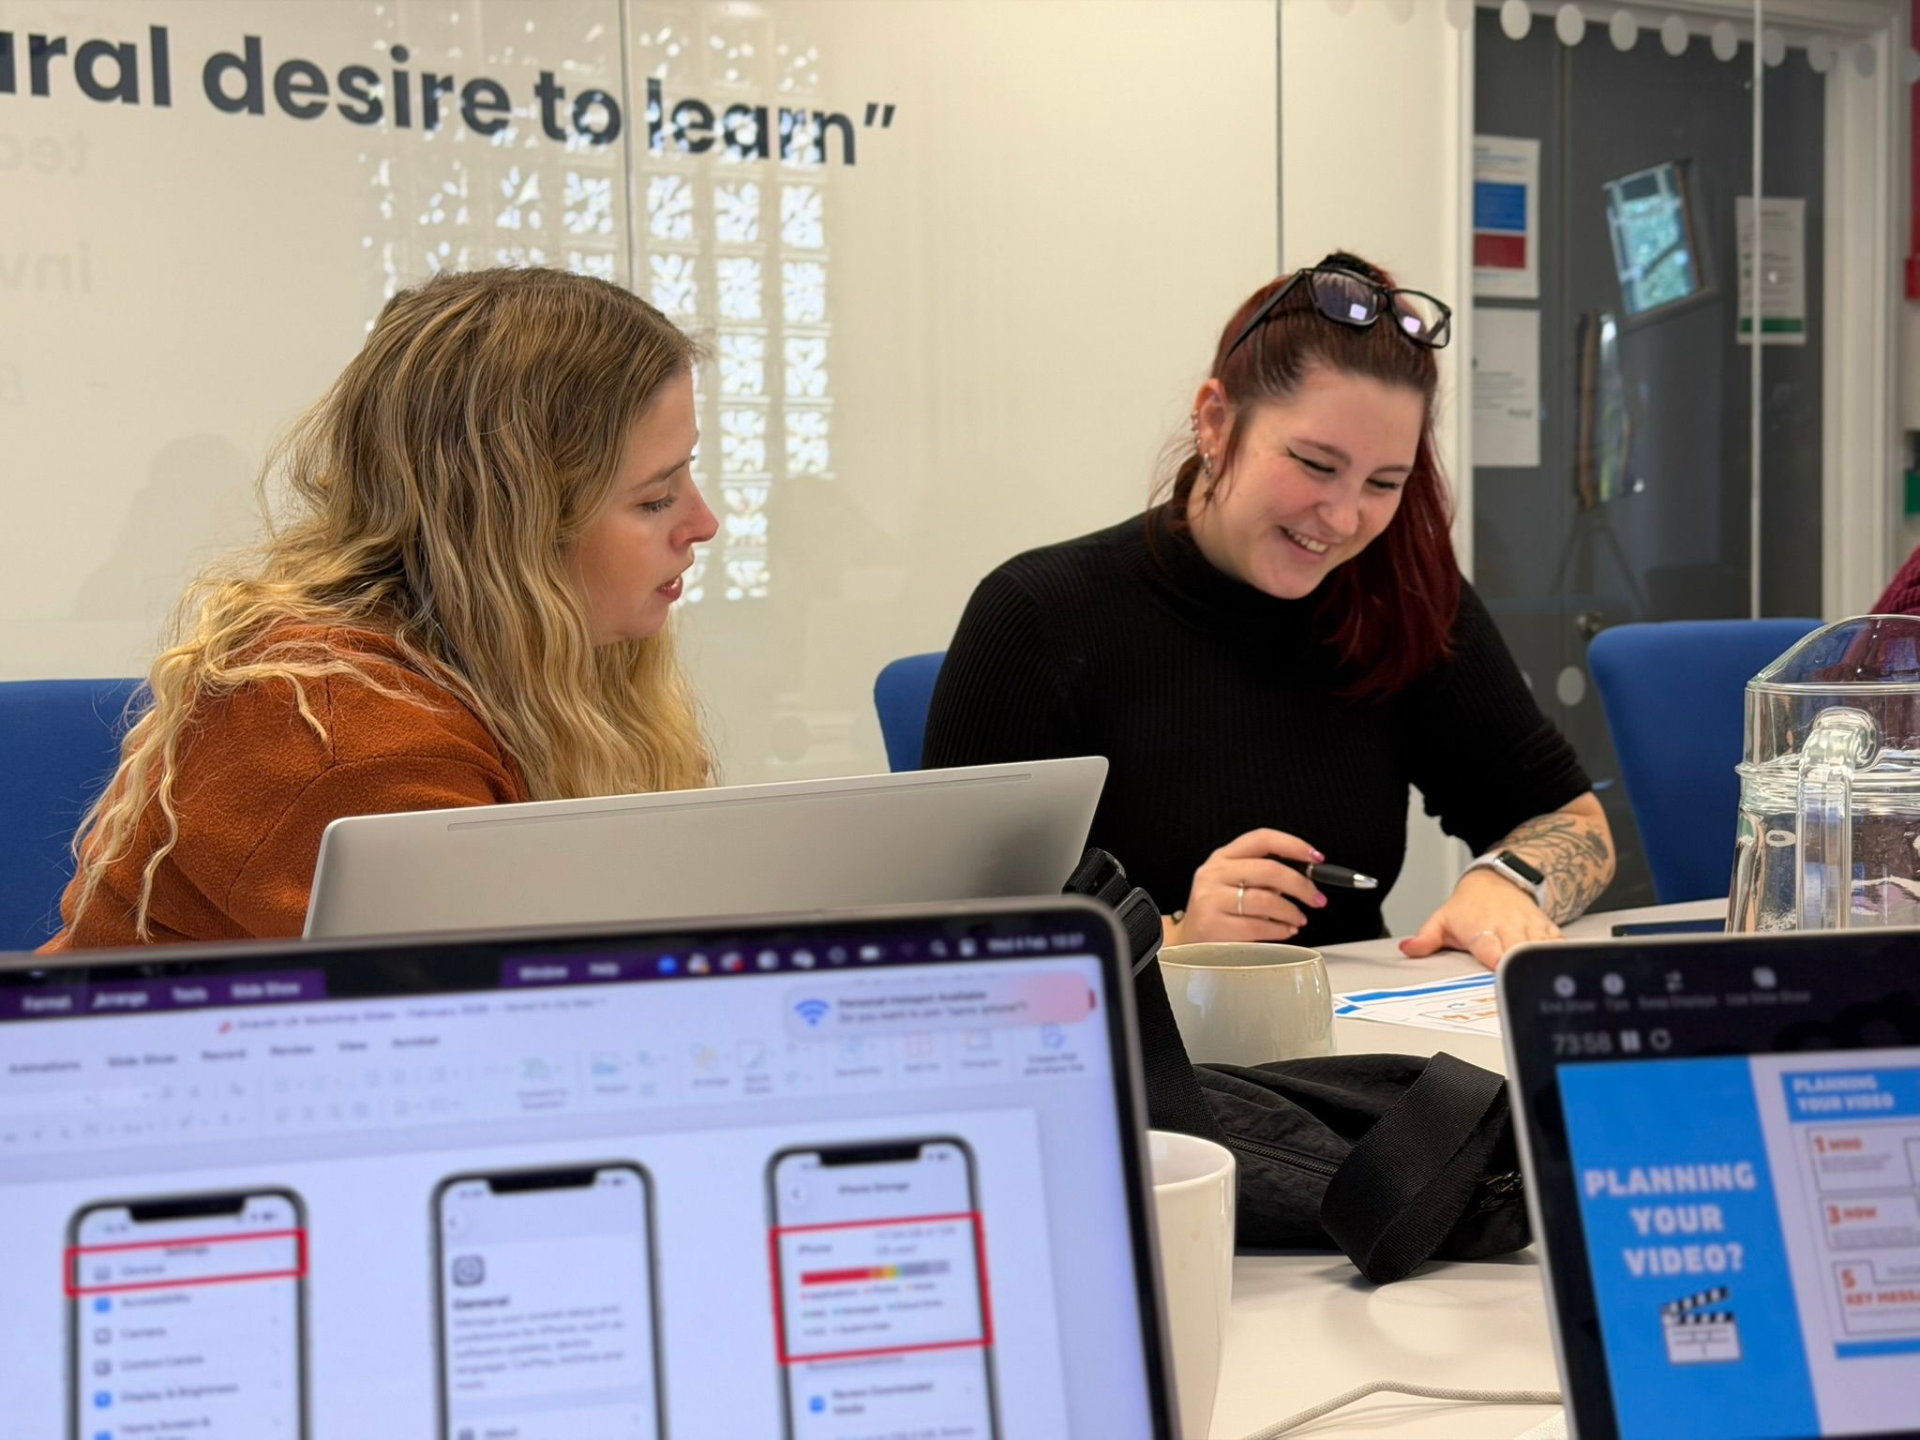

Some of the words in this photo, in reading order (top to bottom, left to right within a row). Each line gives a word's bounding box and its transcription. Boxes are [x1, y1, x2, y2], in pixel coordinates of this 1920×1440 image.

[203, 35, 511, 136] desire
[534, 70, 622, 147] to
[1792, 1074, 1878, 1093] PLANNING
[1796, 1095, 1843, 1113] YOUR
[1845, 1092, 1895, 1111] VIDEO
[1583, 1162, 1756, 1198] PLANNING
[1630, 1204, 1724, 1237] YOUR
[1622, 1243, 1744, 1277] VIDEO?
